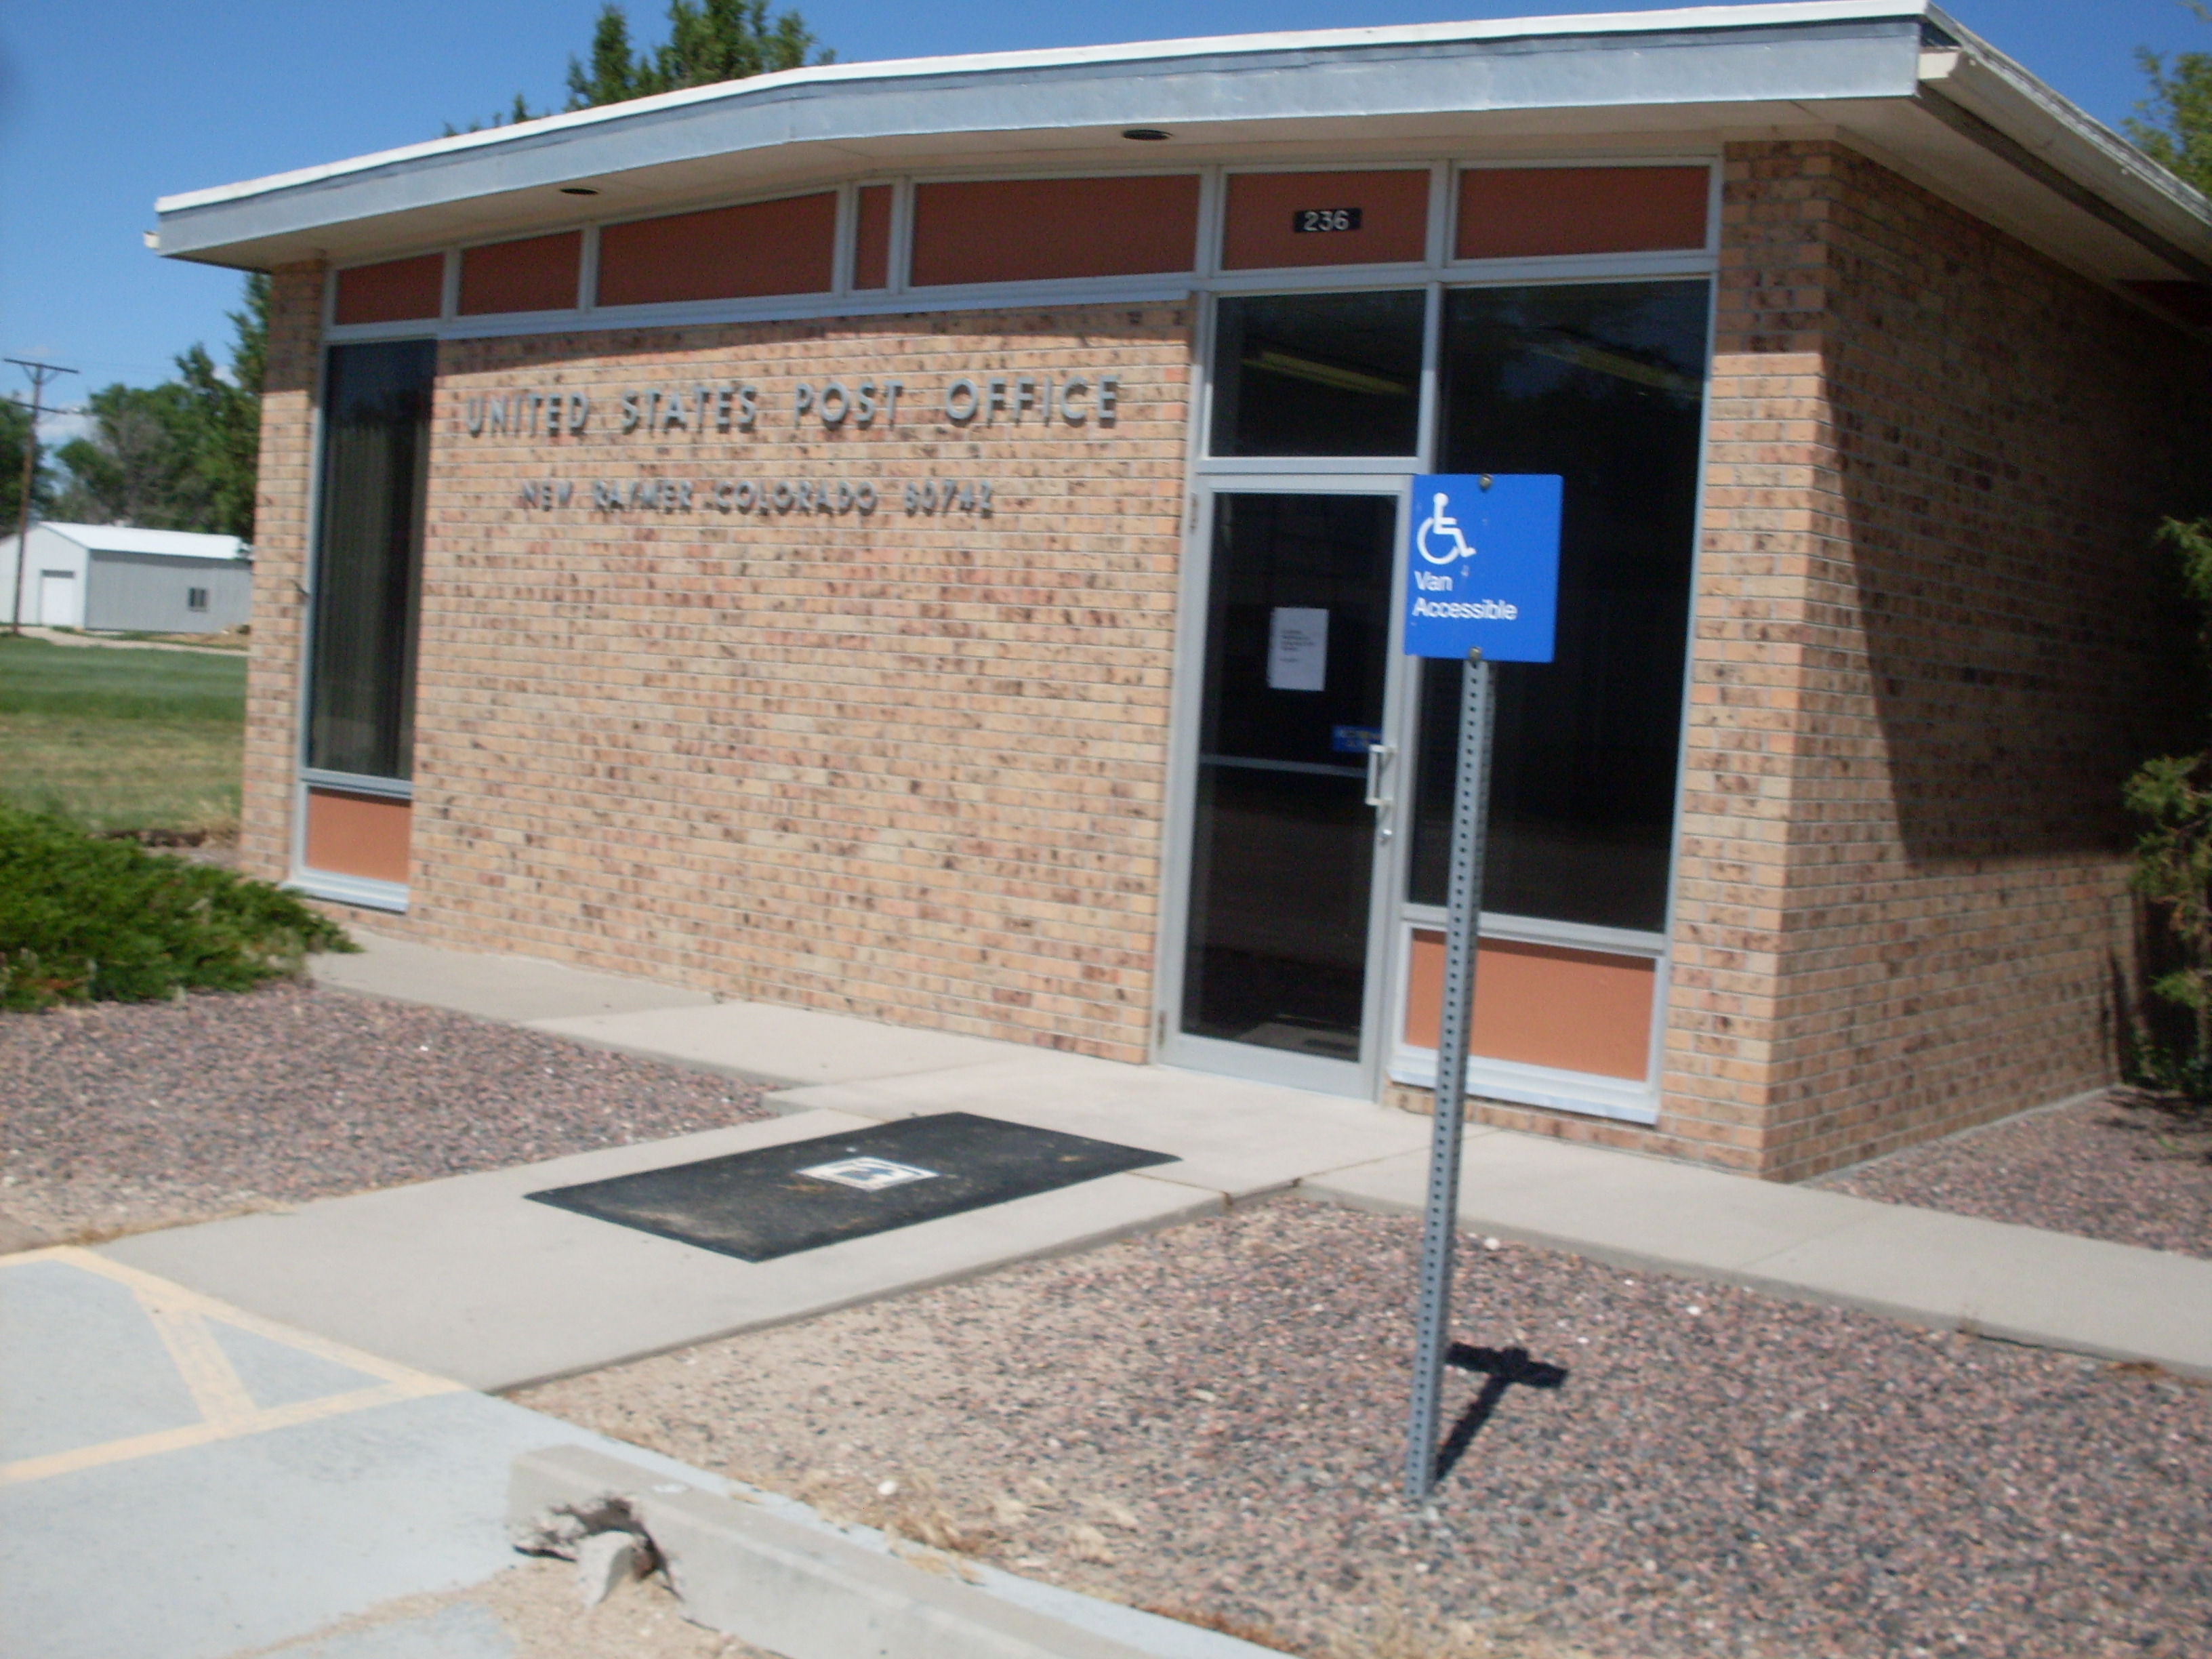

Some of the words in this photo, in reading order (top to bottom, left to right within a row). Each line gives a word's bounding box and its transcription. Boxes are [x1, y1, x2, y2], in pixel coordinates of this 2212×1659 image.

[1303, 210, 1349, 231] 236
[467, 391, 588, 438] UNITED
[621, 385, 757, 434] STATES
[796, 379, 903, 430] POST
[946, 374, 1118, 428] OFFICE
[523, 480, 573, 511] NEW
[594, 480, 692, 513] RAYMER
[715, 480, 876, 518] COLORADO
[1414, 571, 1453, 591] Van
[1412, 596, 1518, 620] Accessible
